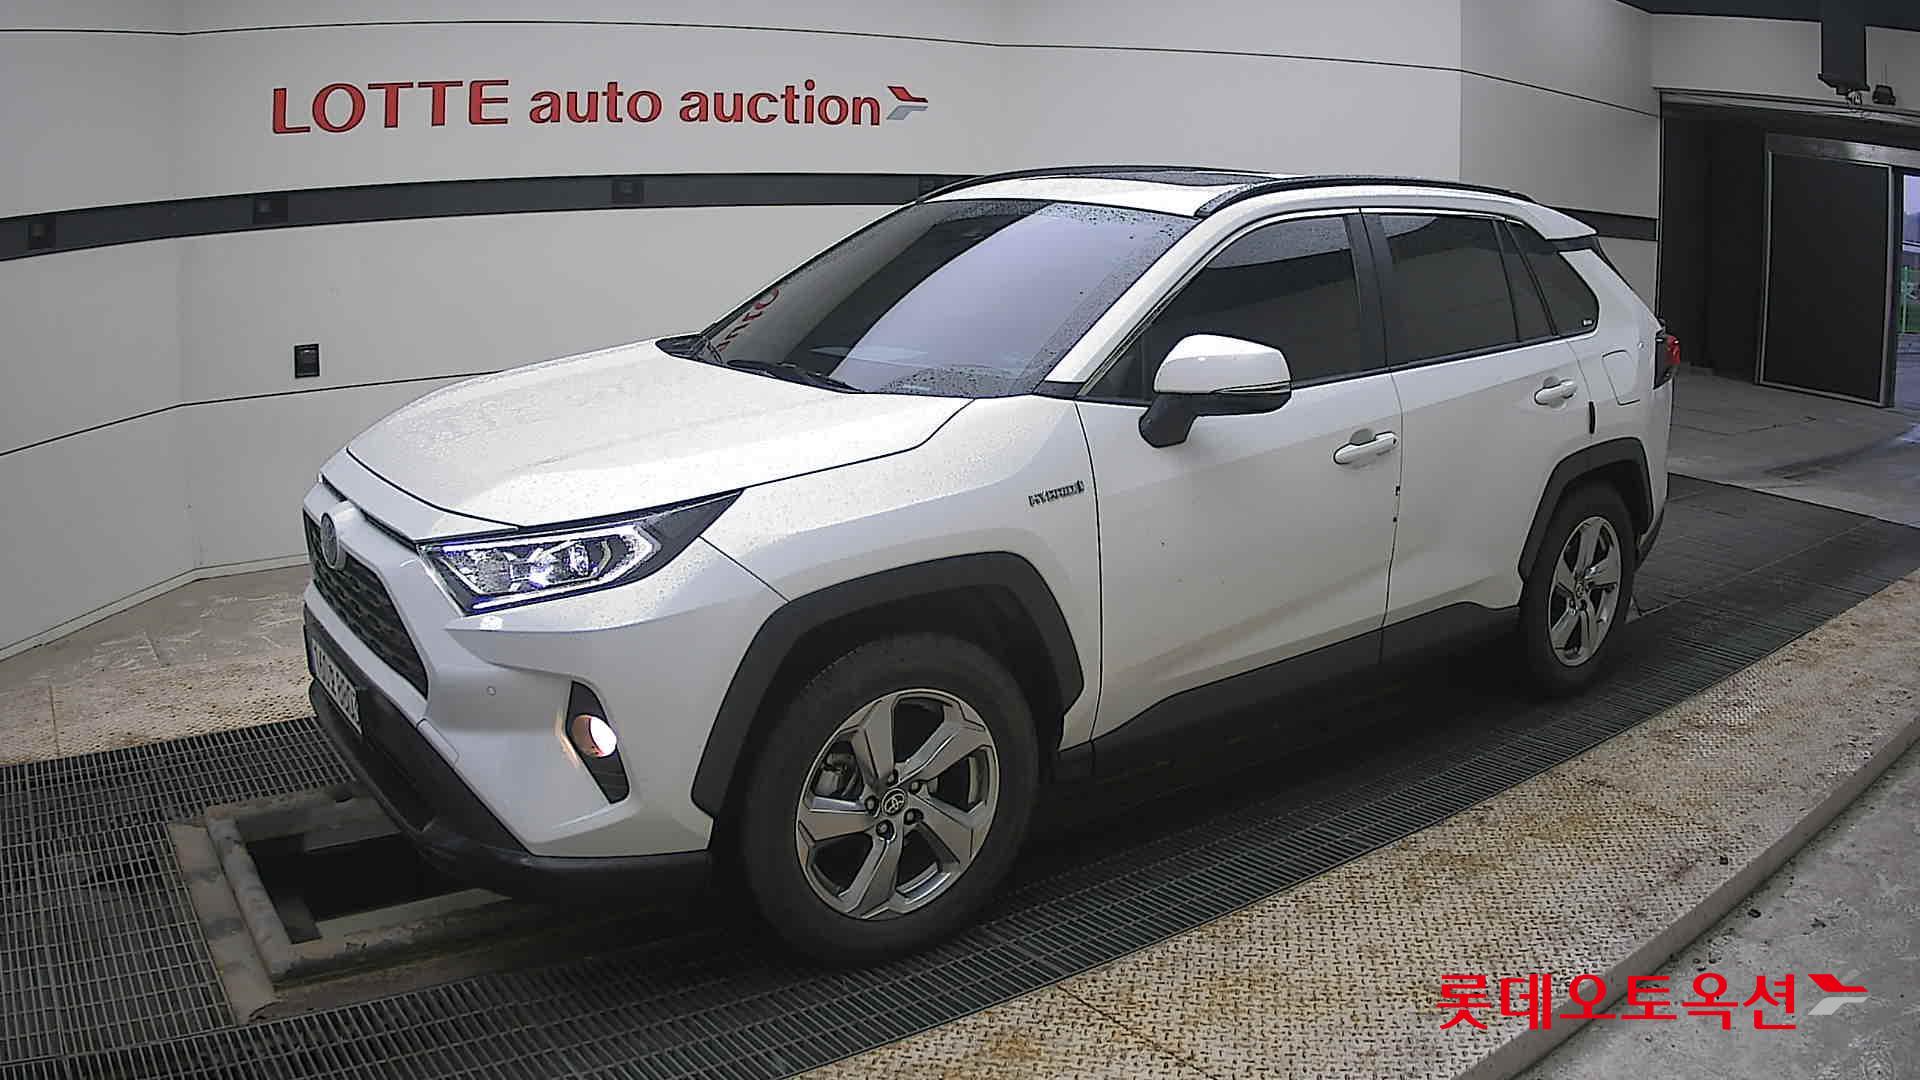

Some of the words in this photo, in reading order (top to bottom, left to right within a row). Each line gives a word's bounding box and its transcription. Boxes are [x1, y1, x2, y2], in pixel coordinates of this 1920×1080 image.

[272, 79, 508, 135] LOTTE
[528, 81, 663, 124] auto
[679, 79, 881, 126] auction
